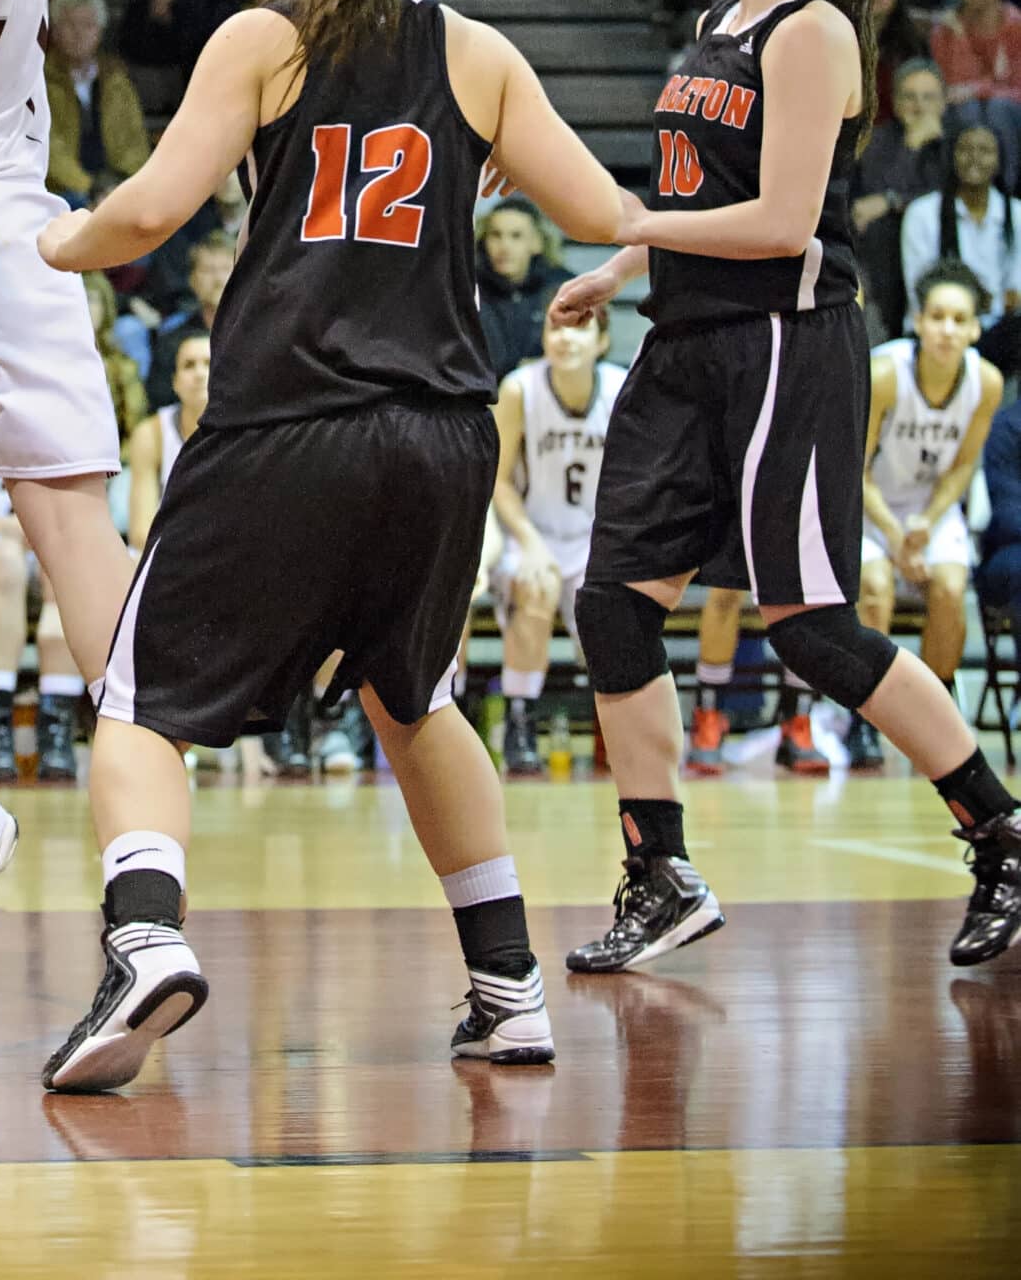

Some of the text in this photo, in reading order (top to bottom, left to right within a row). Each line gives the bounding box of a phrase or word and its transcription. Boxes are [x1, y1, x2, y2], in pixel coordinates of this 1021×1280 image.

[300, 123, 432, 248] 12
[659, 129, 705, 197] 10
[565, 461, 586, 506] 6
